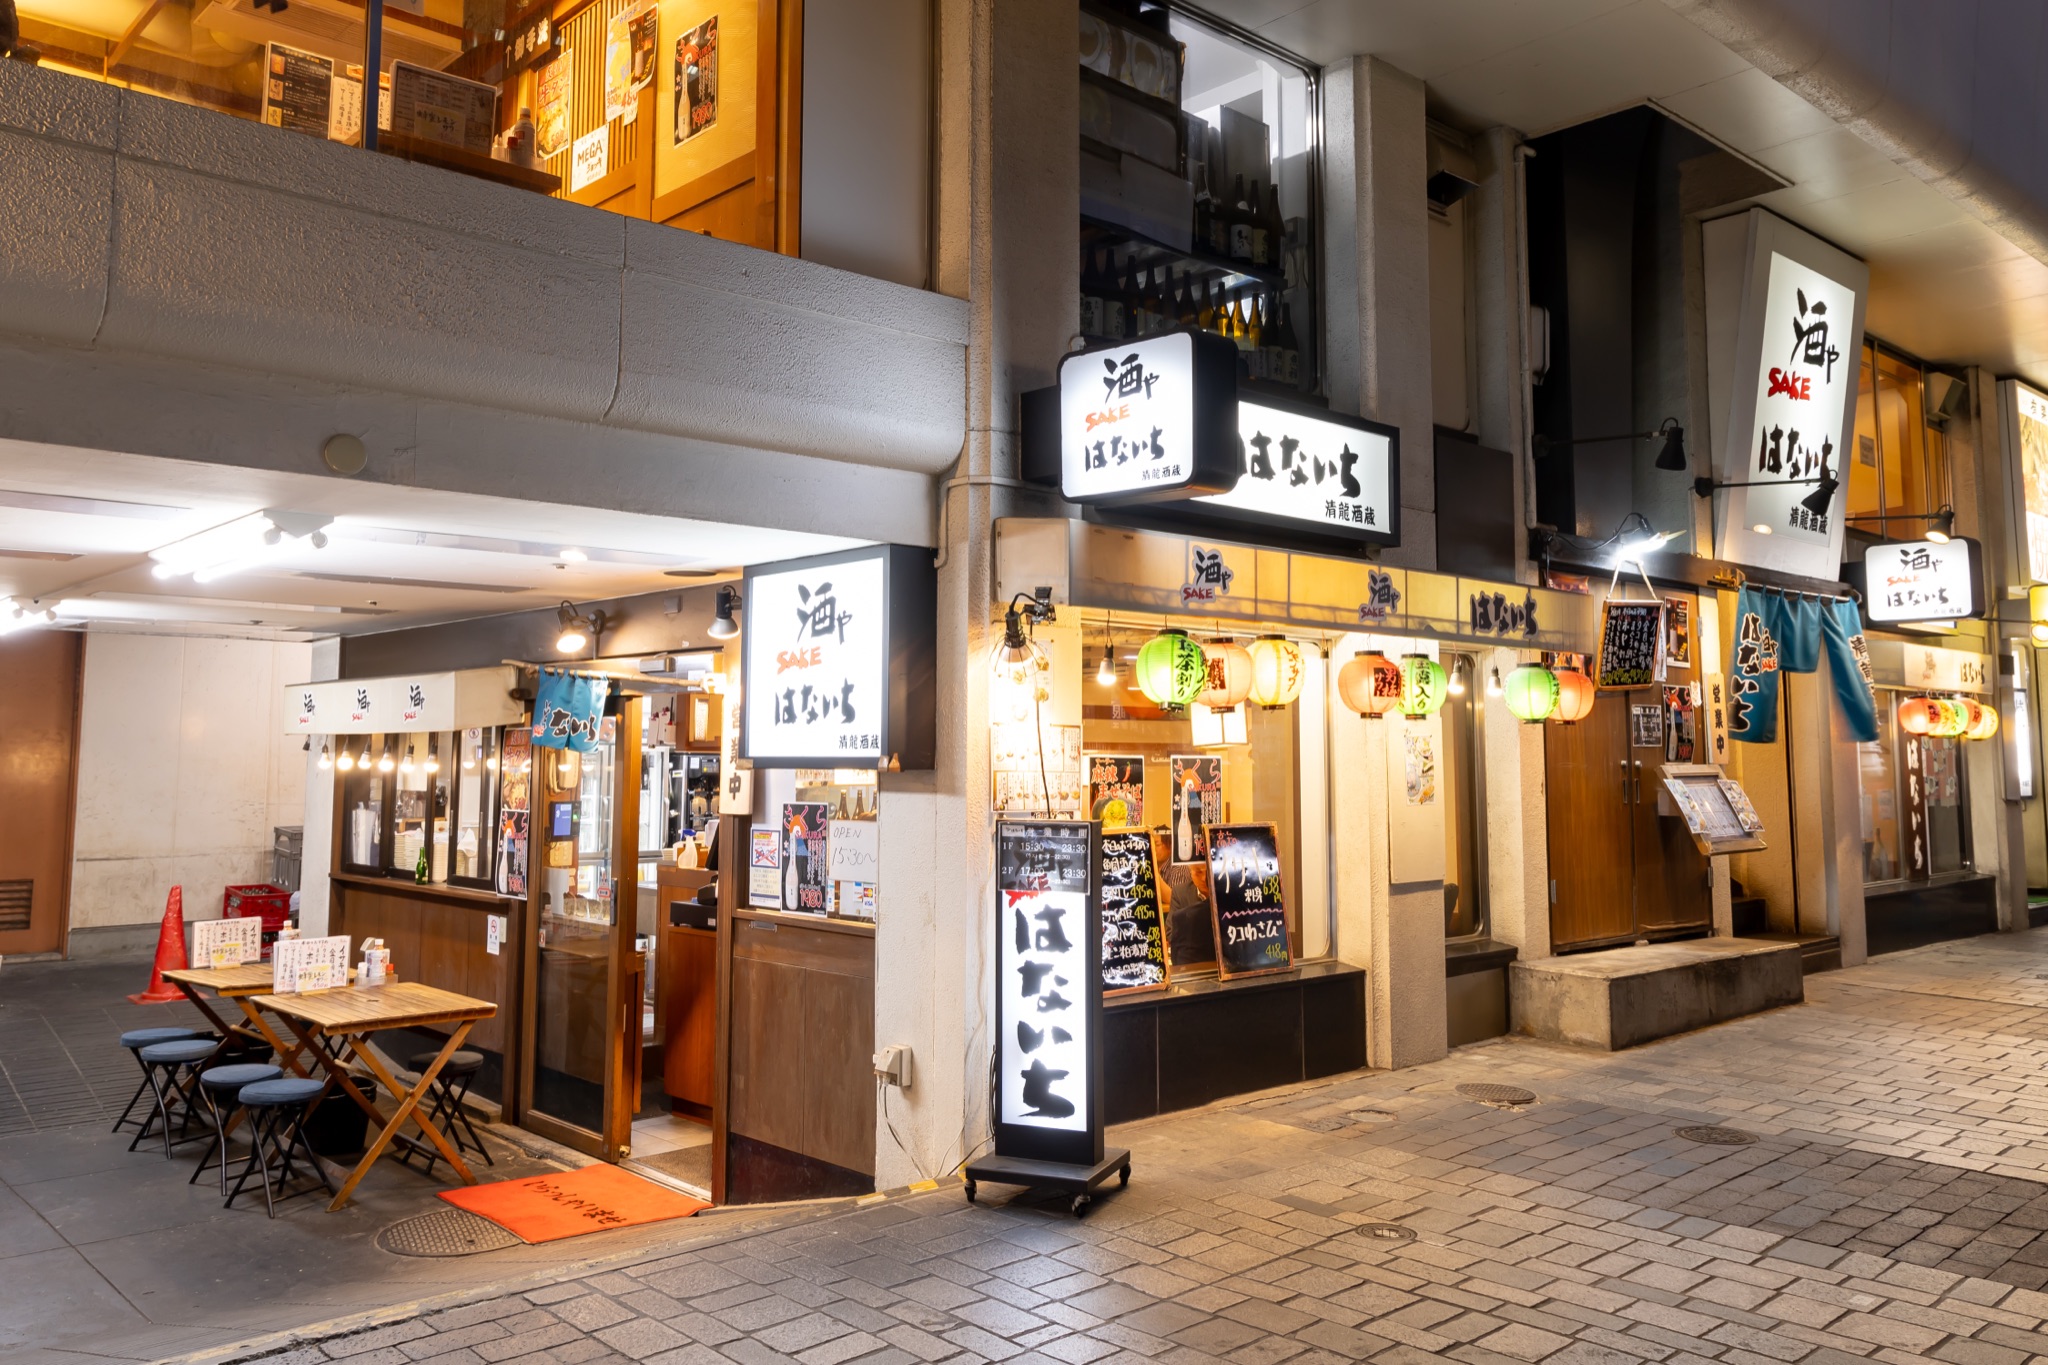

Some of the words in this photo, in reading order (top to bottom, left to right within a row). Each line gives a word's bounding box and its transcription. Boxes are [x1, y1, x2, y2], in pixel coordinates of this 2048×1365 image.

[577, 139, 602, 167] MEGA
[1790, 287, 1840, 384] 酒や
[1103, 353, 1160, 403] 酒や
[1767, 367, 1811, 400] SAKE
[1085, 404, 1131, 433] SAKE
[1085, 425, 1165, 473] はないち
[1758, 424, 1834, 480] はないち
[1141, 464, 1182, 481] 清龍酒蔵
[1238, 430, 1362, 498] はないち
[1325, 499, 1376, 526] 清龍酒蔵
[1196, 550, 1231, 590] 酒や
[1900, 548, 1944, 573] 酒や
[1183, 587, 1213, 601] SAKE
[1370, 573, 1399, 610] 酒や
[1887, 587, 1950, 608] はないち
[797, 582, 852, 644] 酒や
[1360, 606, 1385, 619] SAKE
[1470, 593, 1538, 636] はないち
[776, 646, 822, 674] SAKE
[1175, 639, 1195, 698] お茶割り
[1730, 613, 1760, 732] はないち
[1415, 661, 1430, 709] 玉露入り
[775, 677, 856, 726] はないち
[1712, 683, 1725, 755] 営業中
[838, 734, 880, 749] 清龍酒蔵
[1098, 783, 1143, 799] まぜそば
[1907, 738, 1924, 870] はないち
[833, 827, 862, 839] OPEN
[1020, 842, 1045, 852] 15:30
[1062, 844, 1087, 853] 23:30
[1002, 867, 1014, 875] 2F
[1020, 866, 1045, 876] 17:00
[1062, 868, 1087, 878] 23:30
[800, 888, 823, 908] 1980
[1244, 886, 1263, 903] 刺身
[1227, 919, 1283, 945] タコわさび
[1265, 943, 1288, 961] 418円
[1015, 903, 1076, 1118] はないち
